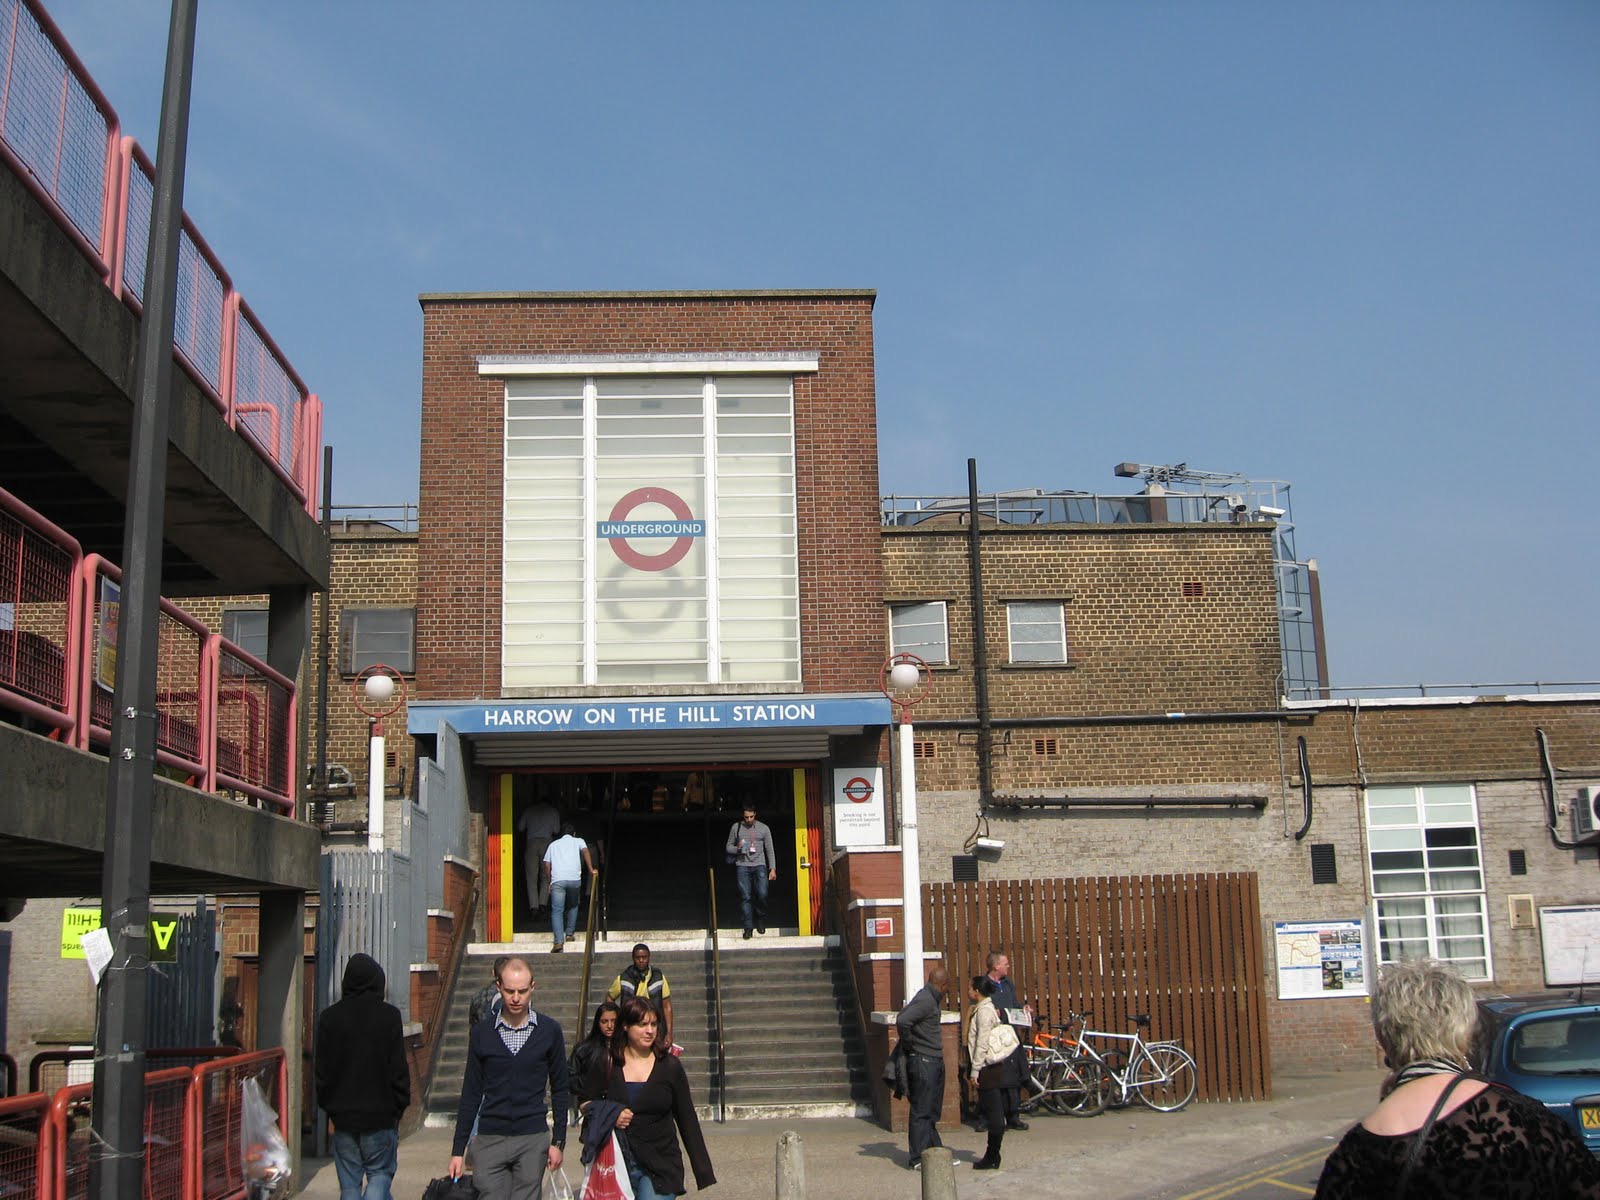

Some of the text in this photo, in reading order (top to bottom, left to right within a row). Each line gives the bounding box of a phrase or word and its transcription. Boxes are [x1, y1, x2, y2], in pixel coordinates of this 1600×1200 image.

[601, 523, 702, 535] UNDERGROUND
[484, 704, 816, 726] HARROW ON THE HILL STATION
[151, 921, 177, 950] A
